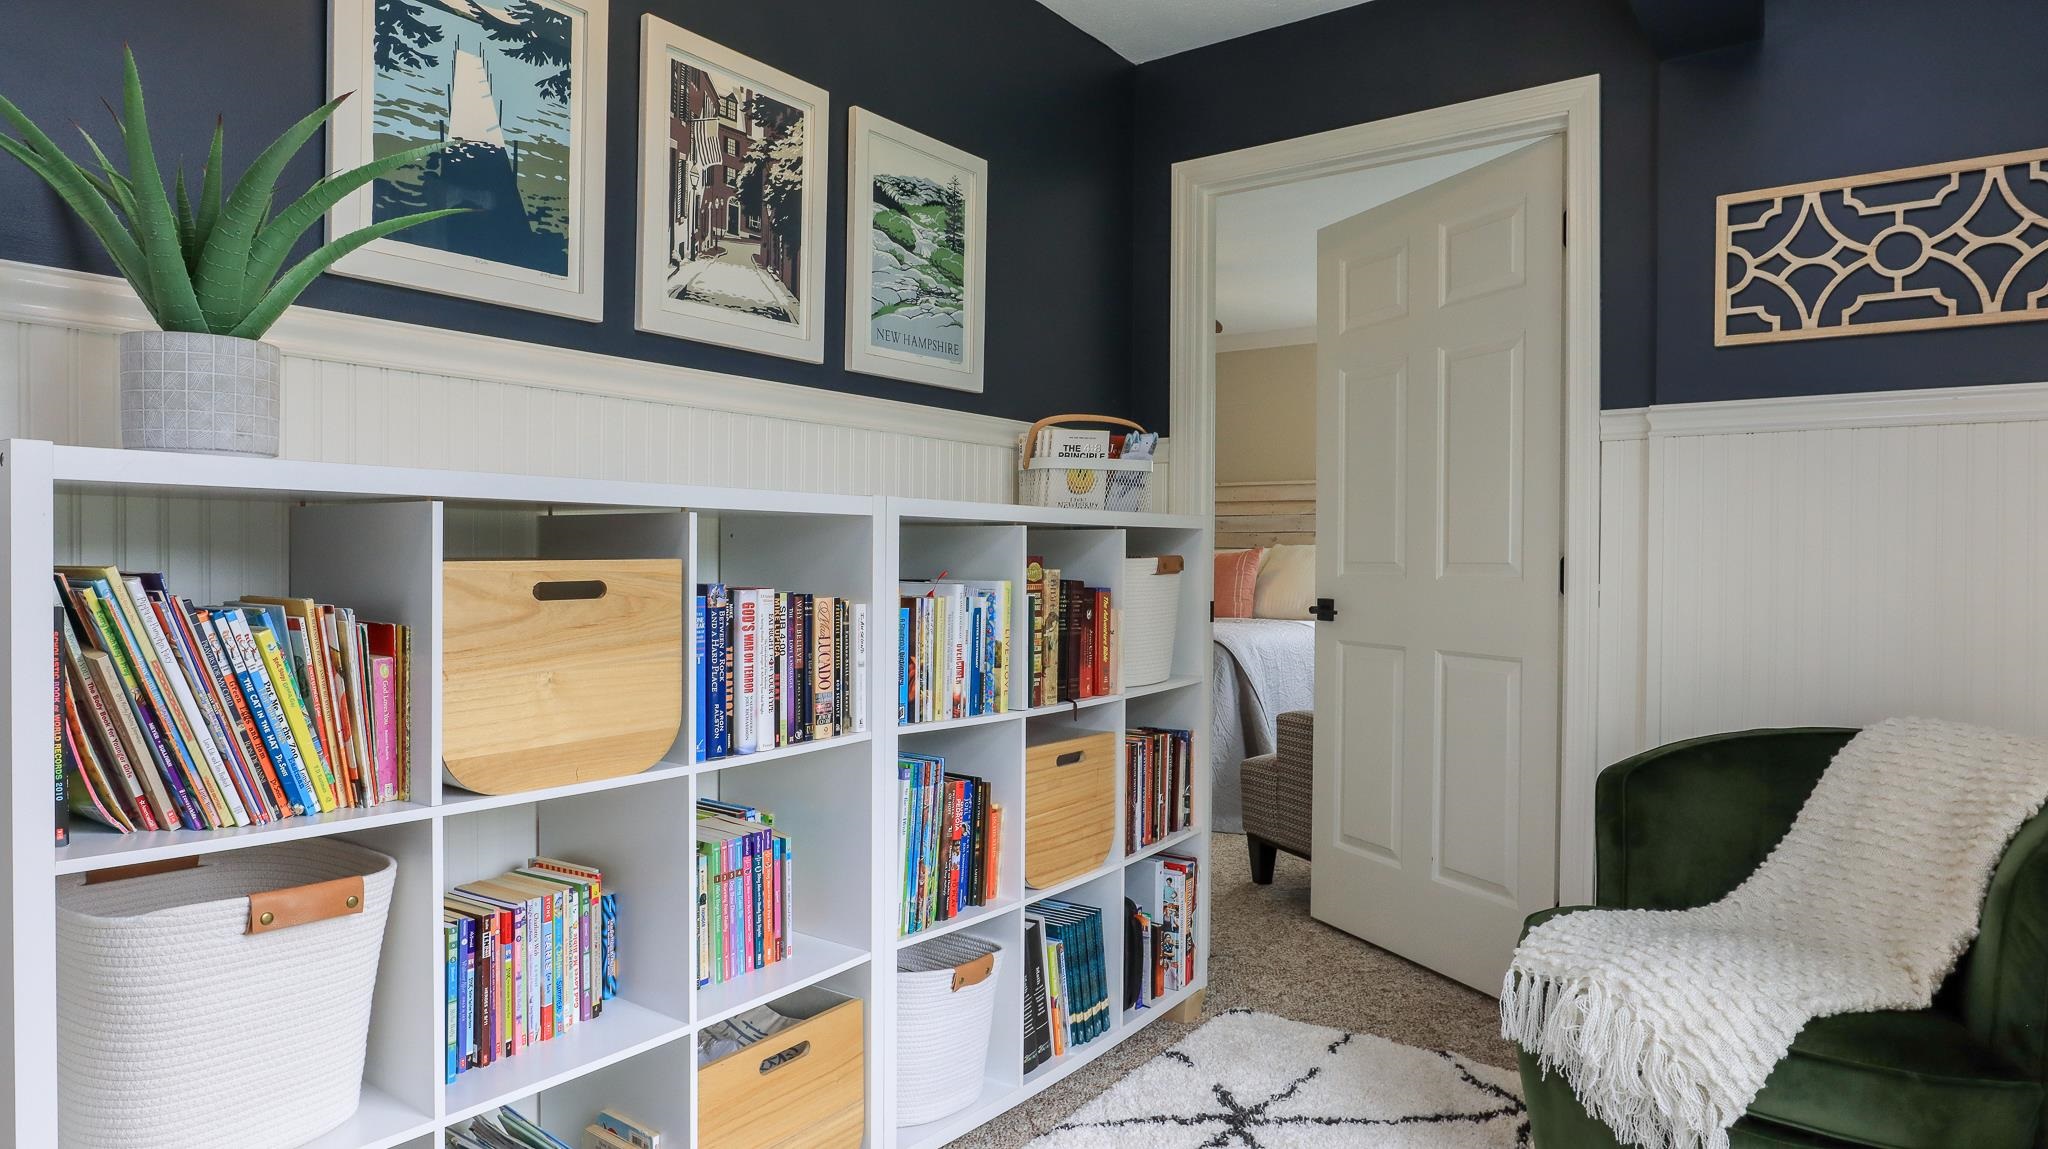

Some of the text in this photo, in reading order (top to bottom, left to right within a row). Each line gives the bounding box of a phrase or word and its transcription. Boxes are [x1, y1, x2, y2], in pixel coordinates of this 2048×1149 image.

[876, 327, 959, 356] NEW HAMPSHIRE
[1063, 444, 1081, 452] THE
[711, 629, 717, 637] A
[741, 602, 754, 693] GOD'S WAR ON TERROR
[817, 635, 831, 690] LUCADO
[86, 681, 96, 694] The
[91, 693, 104, 711] Body
[242, 677, 278, 751] THE CAT IN THE HAT
[99, 710, 111, 727] Book
[228, 679, 266, 760] Green Eggs and Ham
[262, 680, 300, 760] Put Me in the Zoo
[106, 727, 116, 738] for
[147, 721, 173, 768] MEYER SULLIVAN
[54, 743, 62, 779] RECORDS
[109, 737, 127, 764] Younger
[122, 763, 134, 779] Girls
[274, 754, 288, 777] Dr. Seuss
[55, 782, 63, 800] 2010
[953, 798, 961, 831] PEDROIA
[962, 798, 970, 816] JOEL
[544, 933, 552, 969] PARIS
[573, 955, 578, 965] Me
